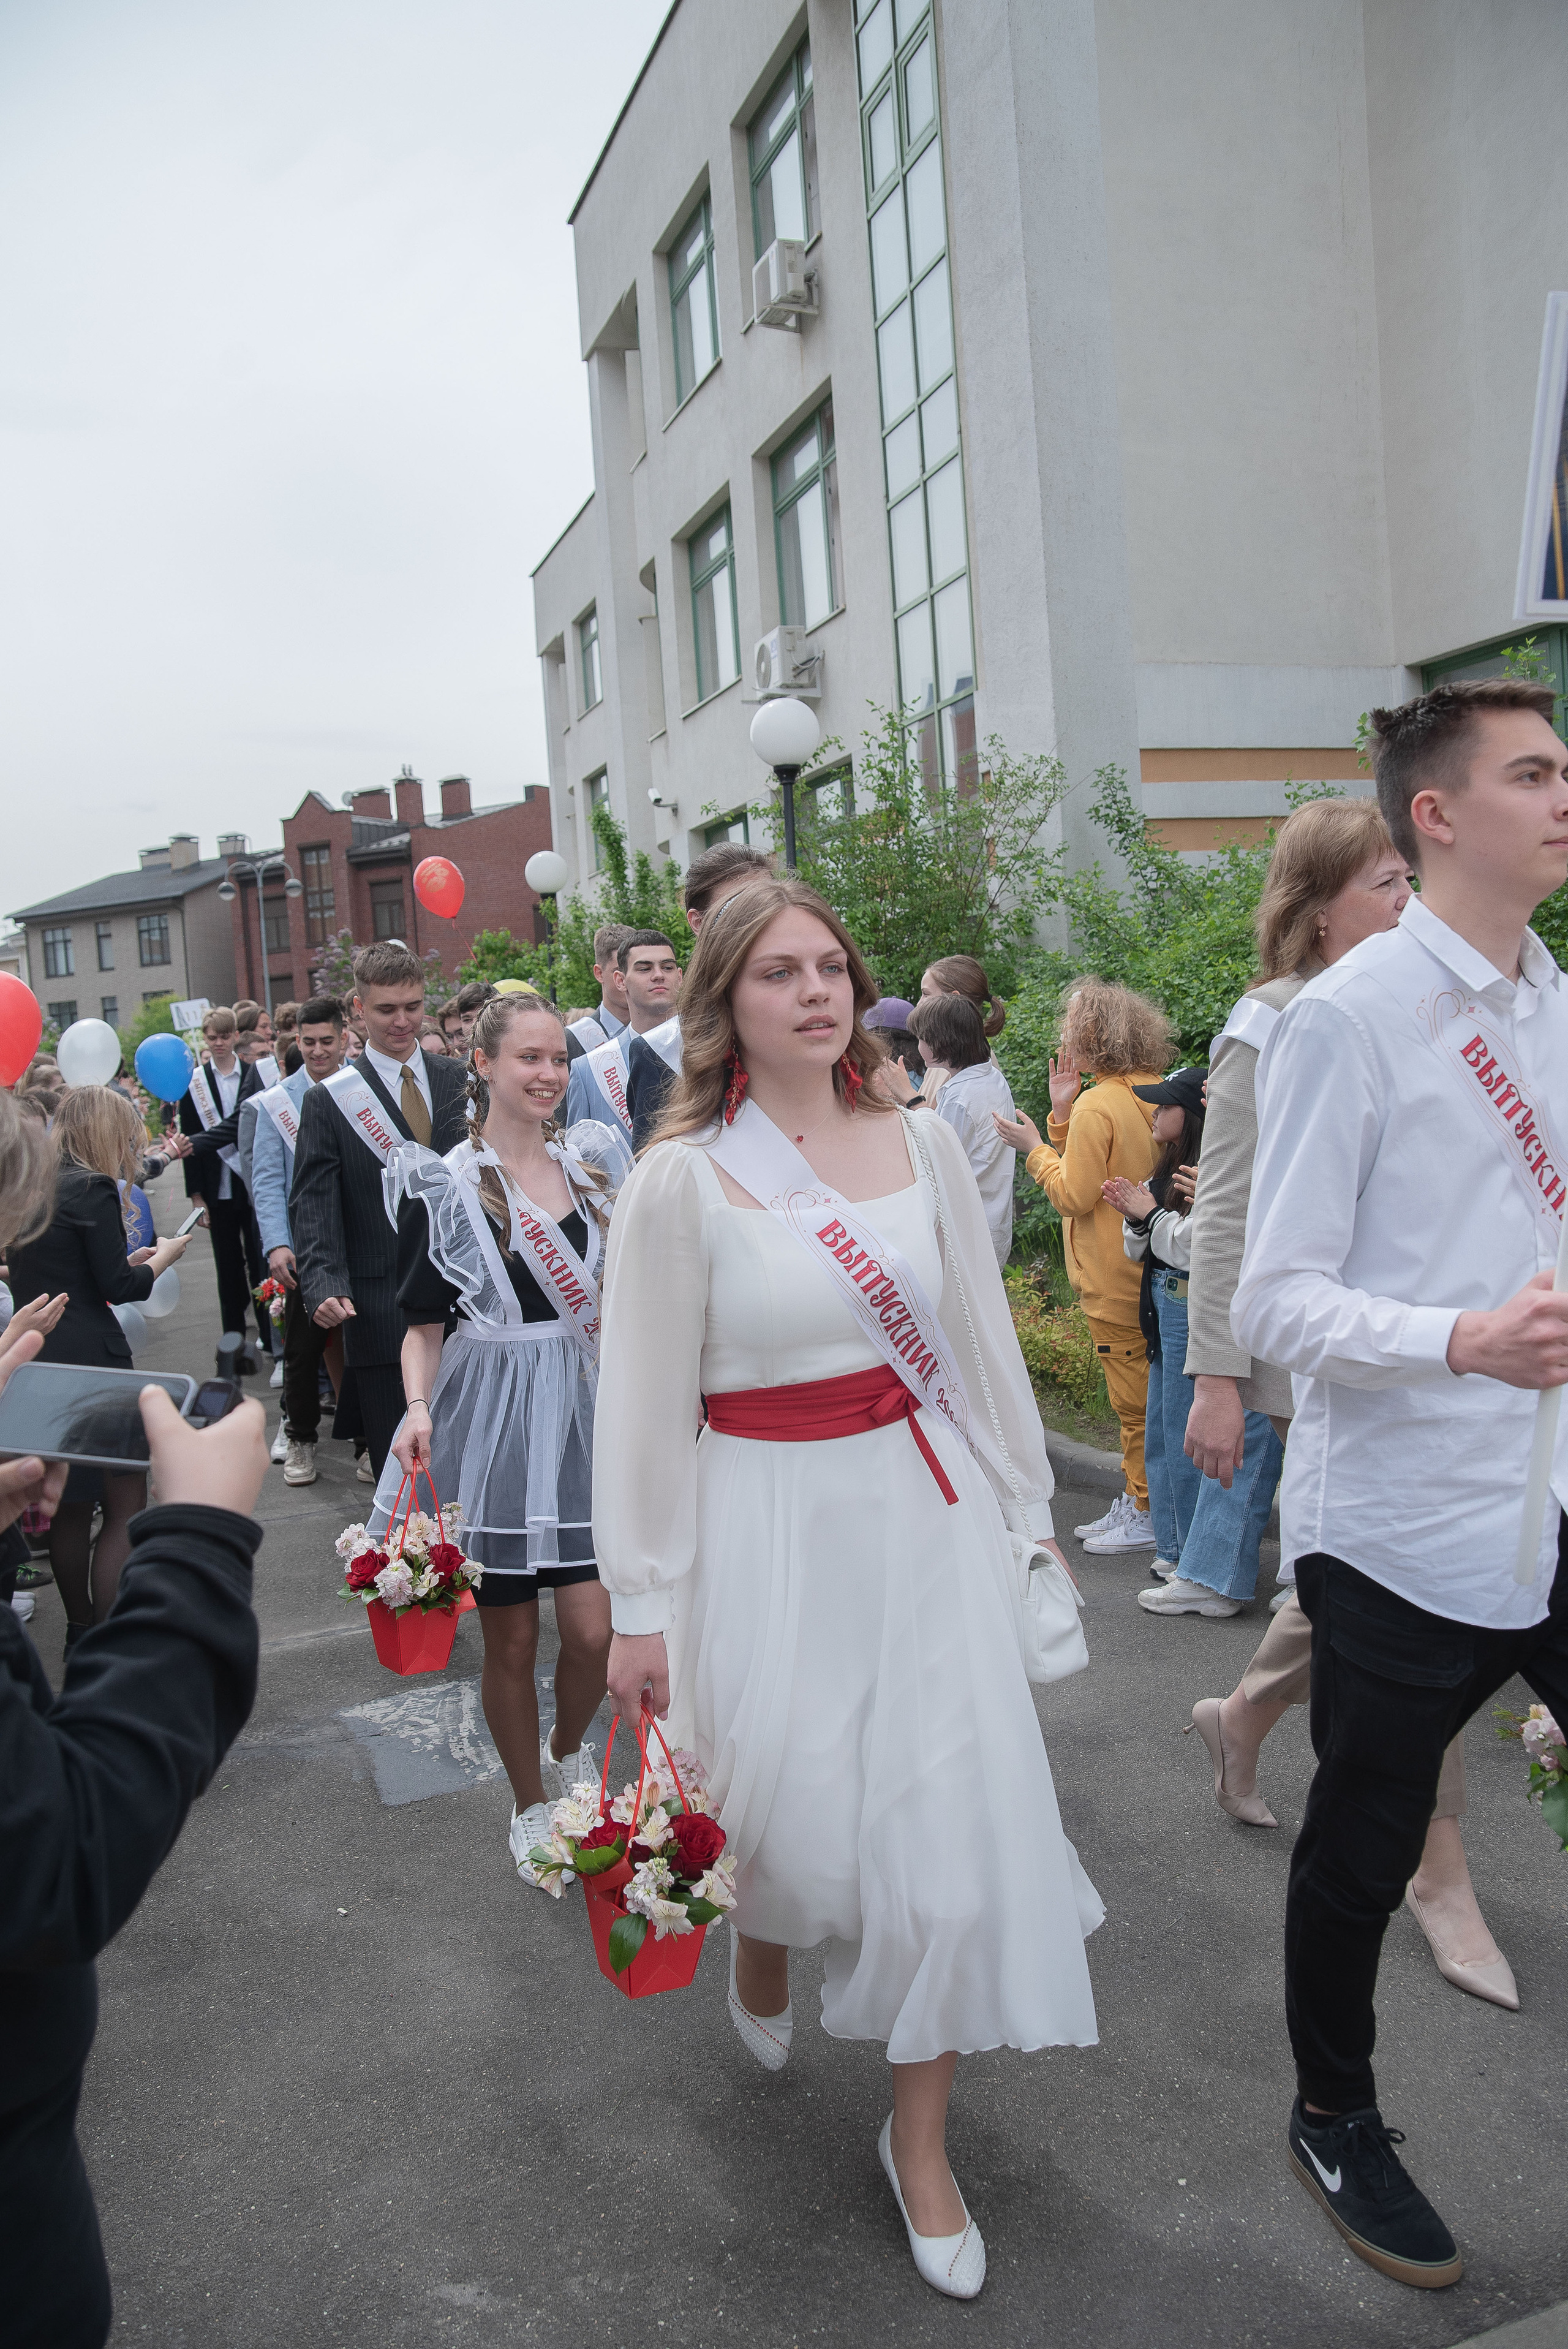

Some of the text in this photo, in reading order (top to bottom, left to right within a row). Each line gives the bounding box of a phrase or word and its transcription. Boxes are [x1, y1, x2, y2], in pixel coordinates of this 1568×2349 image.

[603, 1066, 633, 1131] ВЫПУСК
[1460, 1033, 1567, 1221] ВЫПУСКН
[516, 1206, 592, 1315] ПУСКНИК
[815, 1216, 940, 1391] ВЫПУСКНИК
